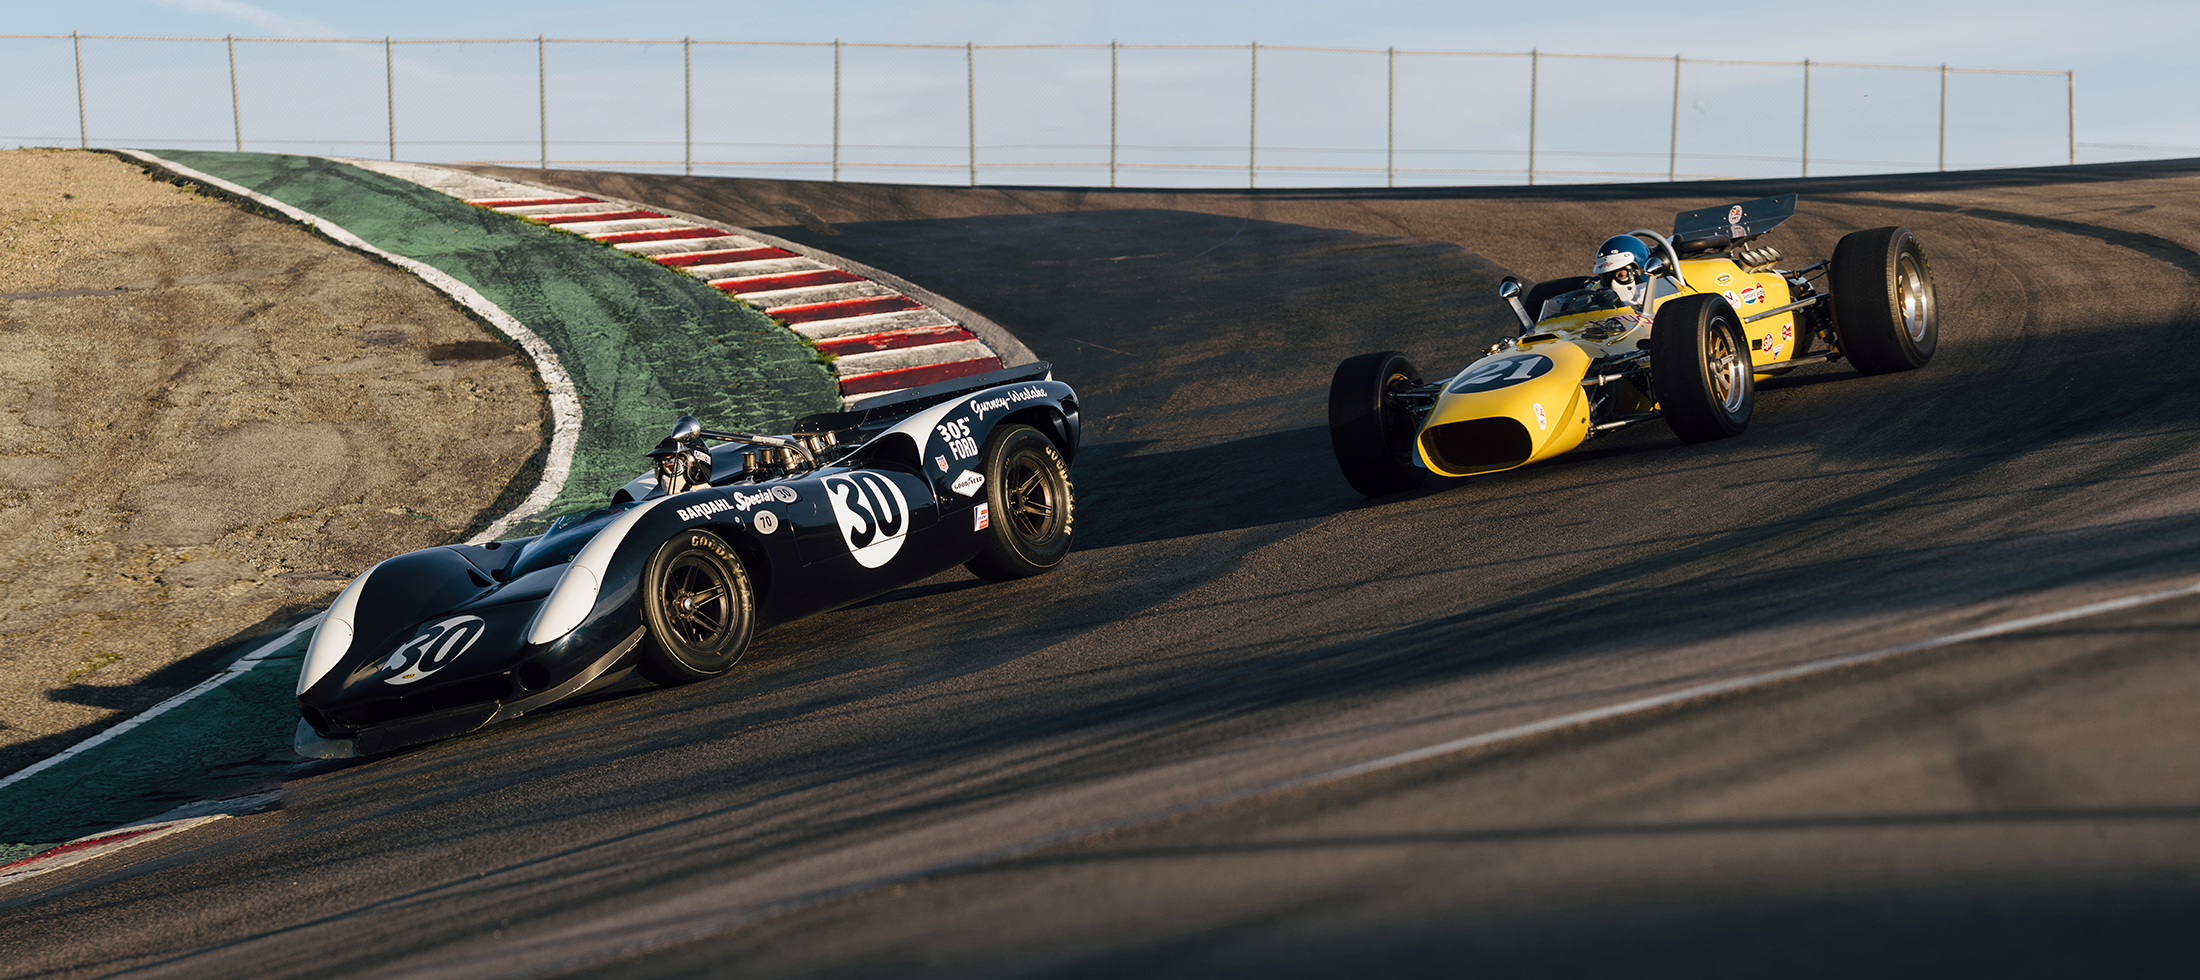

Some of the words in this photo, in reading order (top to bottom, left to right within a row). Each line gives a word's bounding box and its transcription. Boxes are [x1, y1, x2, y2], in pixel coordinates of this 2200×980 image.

[1451, 356, 1543, 391] 21
[694, 451, 711, 464] Mob
[948, 436, 979, 461] FORD
[777, 488, 791, 499] 30
[954, 475, 983, 490] GOODYEAR
[676, 498, 734, 522] BARDAHL
[733, 488, 775, 512] Special
[826, 473, 902, 549] 30
[759, 515, 772, 529] 70
[383, 620, 484, 681] 30
